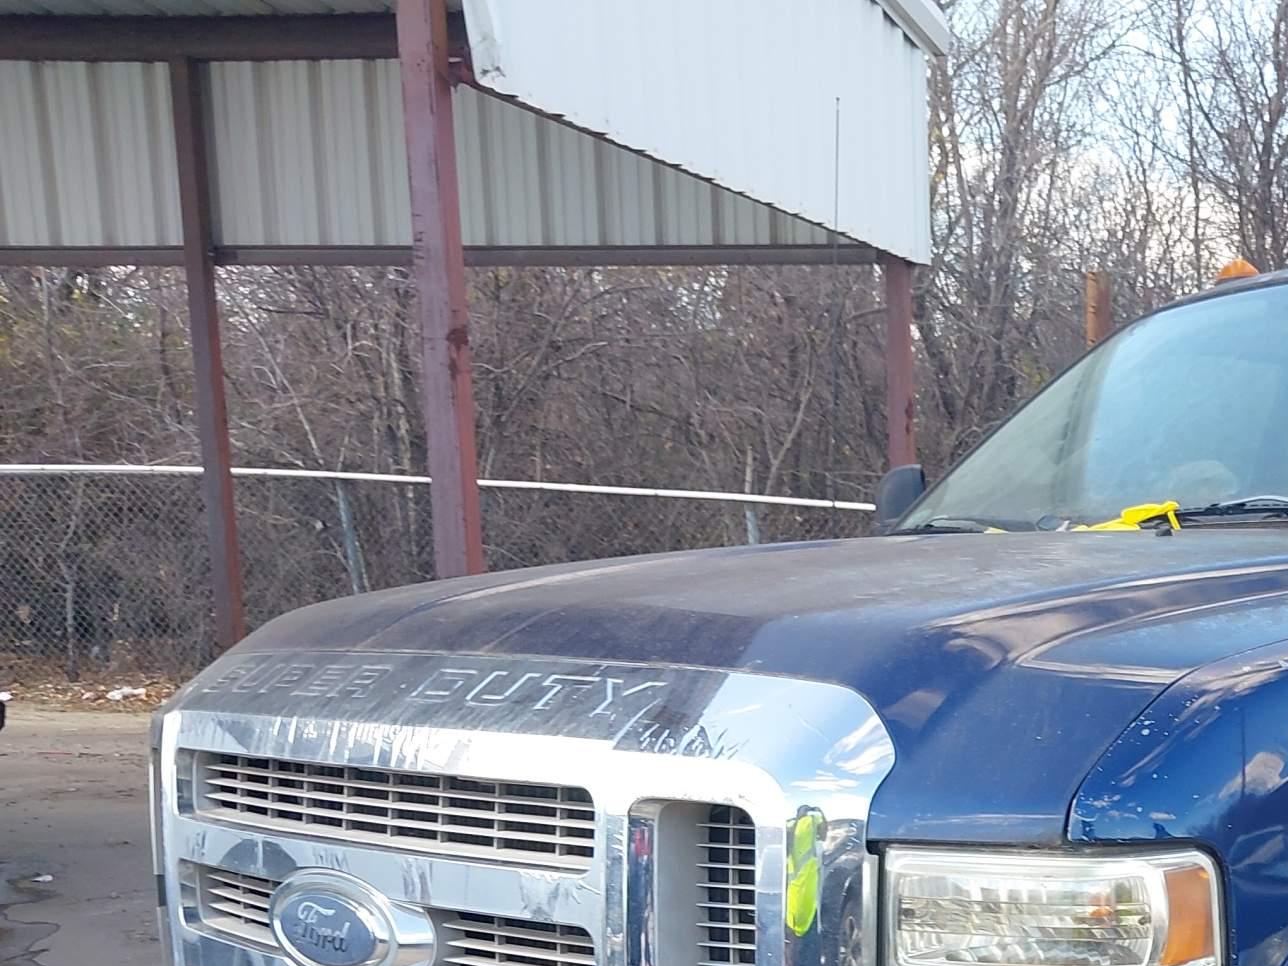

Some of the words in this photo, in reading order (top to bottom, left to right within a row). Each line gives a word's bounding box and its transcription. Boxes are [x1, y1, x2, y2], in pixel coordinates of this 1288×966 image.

[202, 663, 392, 699] SUPER
[408, 668, 668, 717] DUTY
[296, 901, 351, 953] Ford
